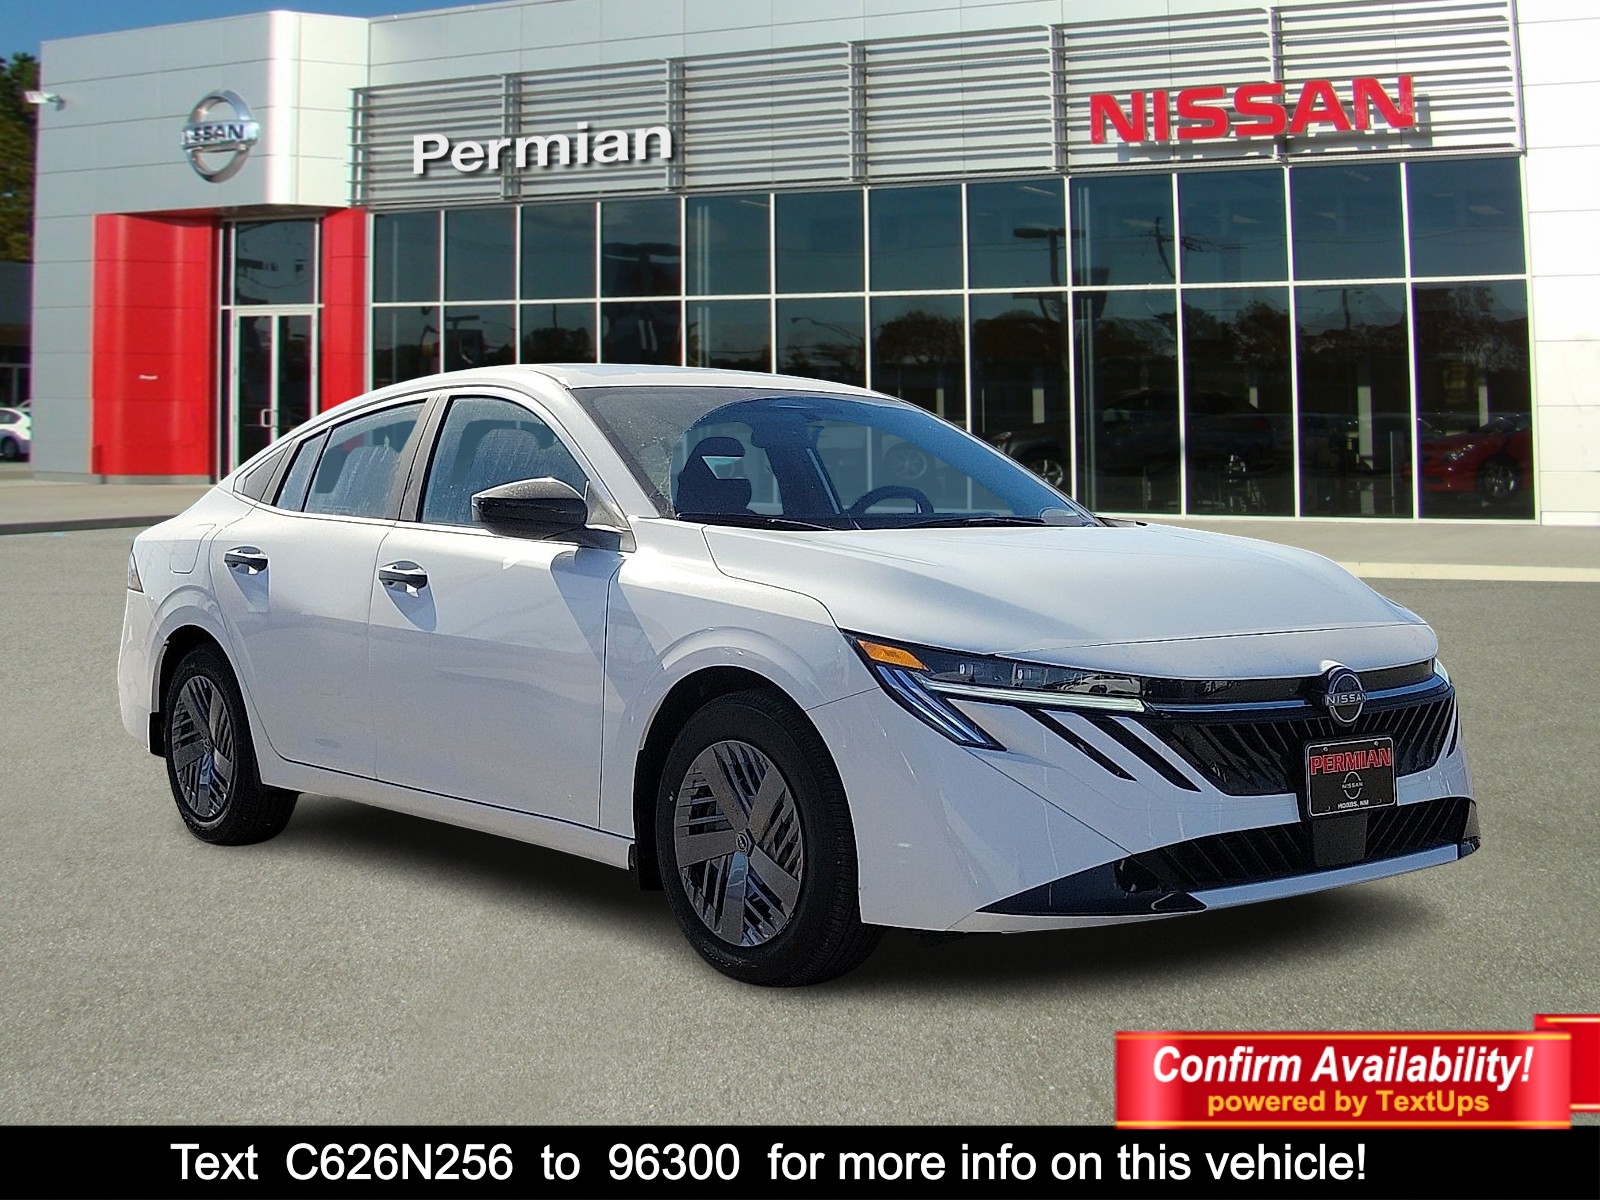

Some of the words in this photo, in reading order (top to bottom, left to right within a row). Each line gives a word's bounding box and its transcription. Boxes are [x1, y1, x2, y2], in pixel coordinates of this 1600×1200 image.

[1090, 75, 1415, 144] NISSAN
[181, 124, 245, 146] SSAN
[413, 121, 672, 175] Permian
[1326, 692, 1367, 705] NISSAN
[1310, 747, 1392, 776] PERMIAN
[1341, 781, 1364, 789] NISSAN
